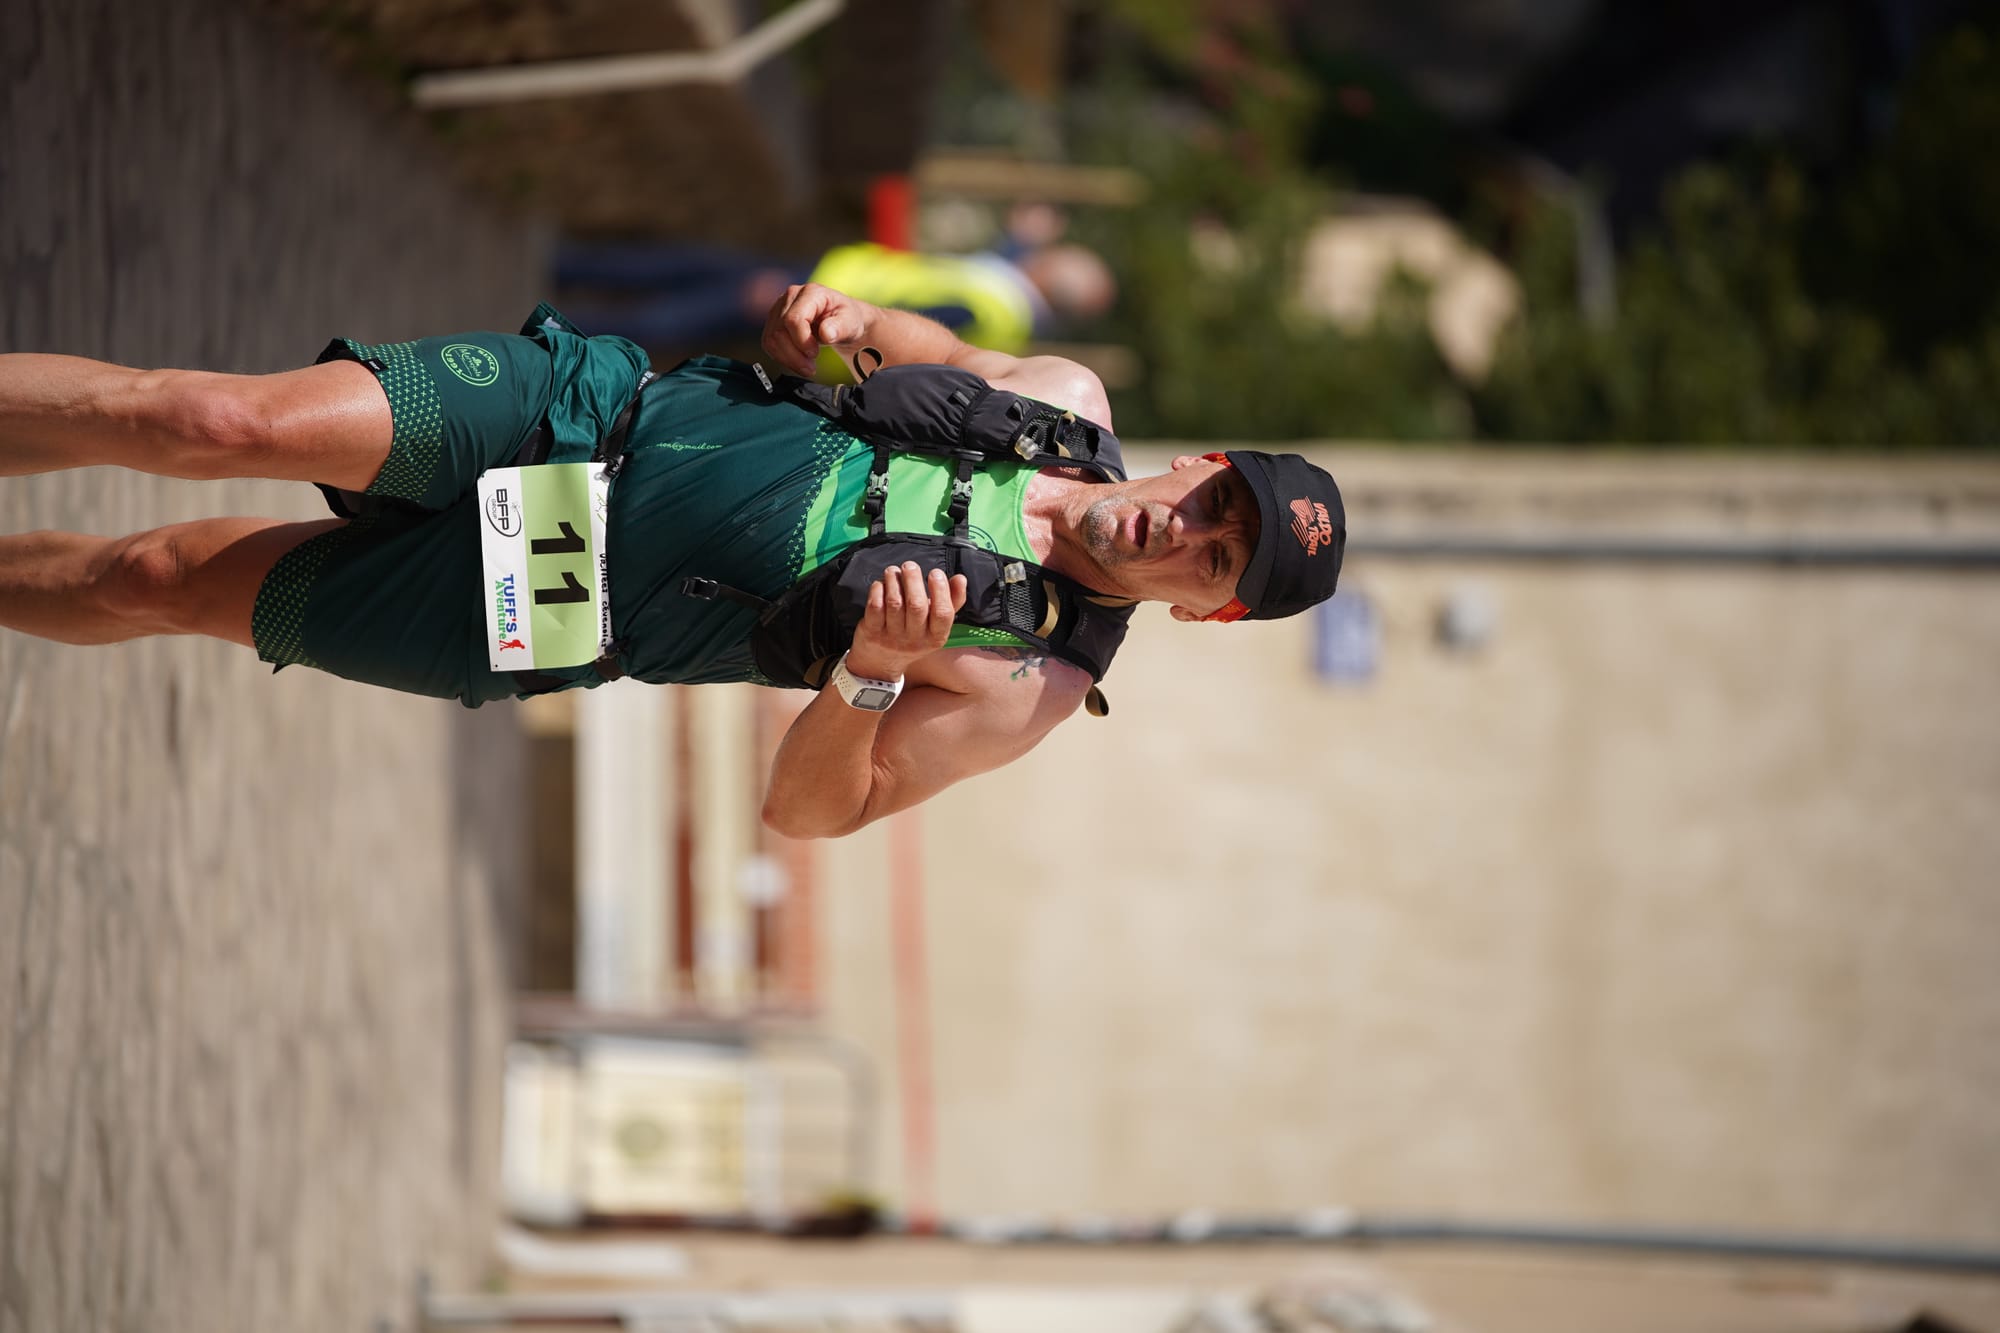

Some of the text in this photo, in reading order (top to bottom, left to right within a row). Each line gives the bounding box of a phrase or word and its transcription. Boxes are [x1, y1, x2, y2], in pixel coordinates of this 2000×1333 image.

[496, 488, 509, 530] BFP
[1313, 502, 1333, 546] VALDO
[530, 521, 590, 605] 11
[1307, 526, 1319, 556] TRAIL
[495, 580, 507, 639] Aventure
[502, 573, 518, 633] TUFF'S
